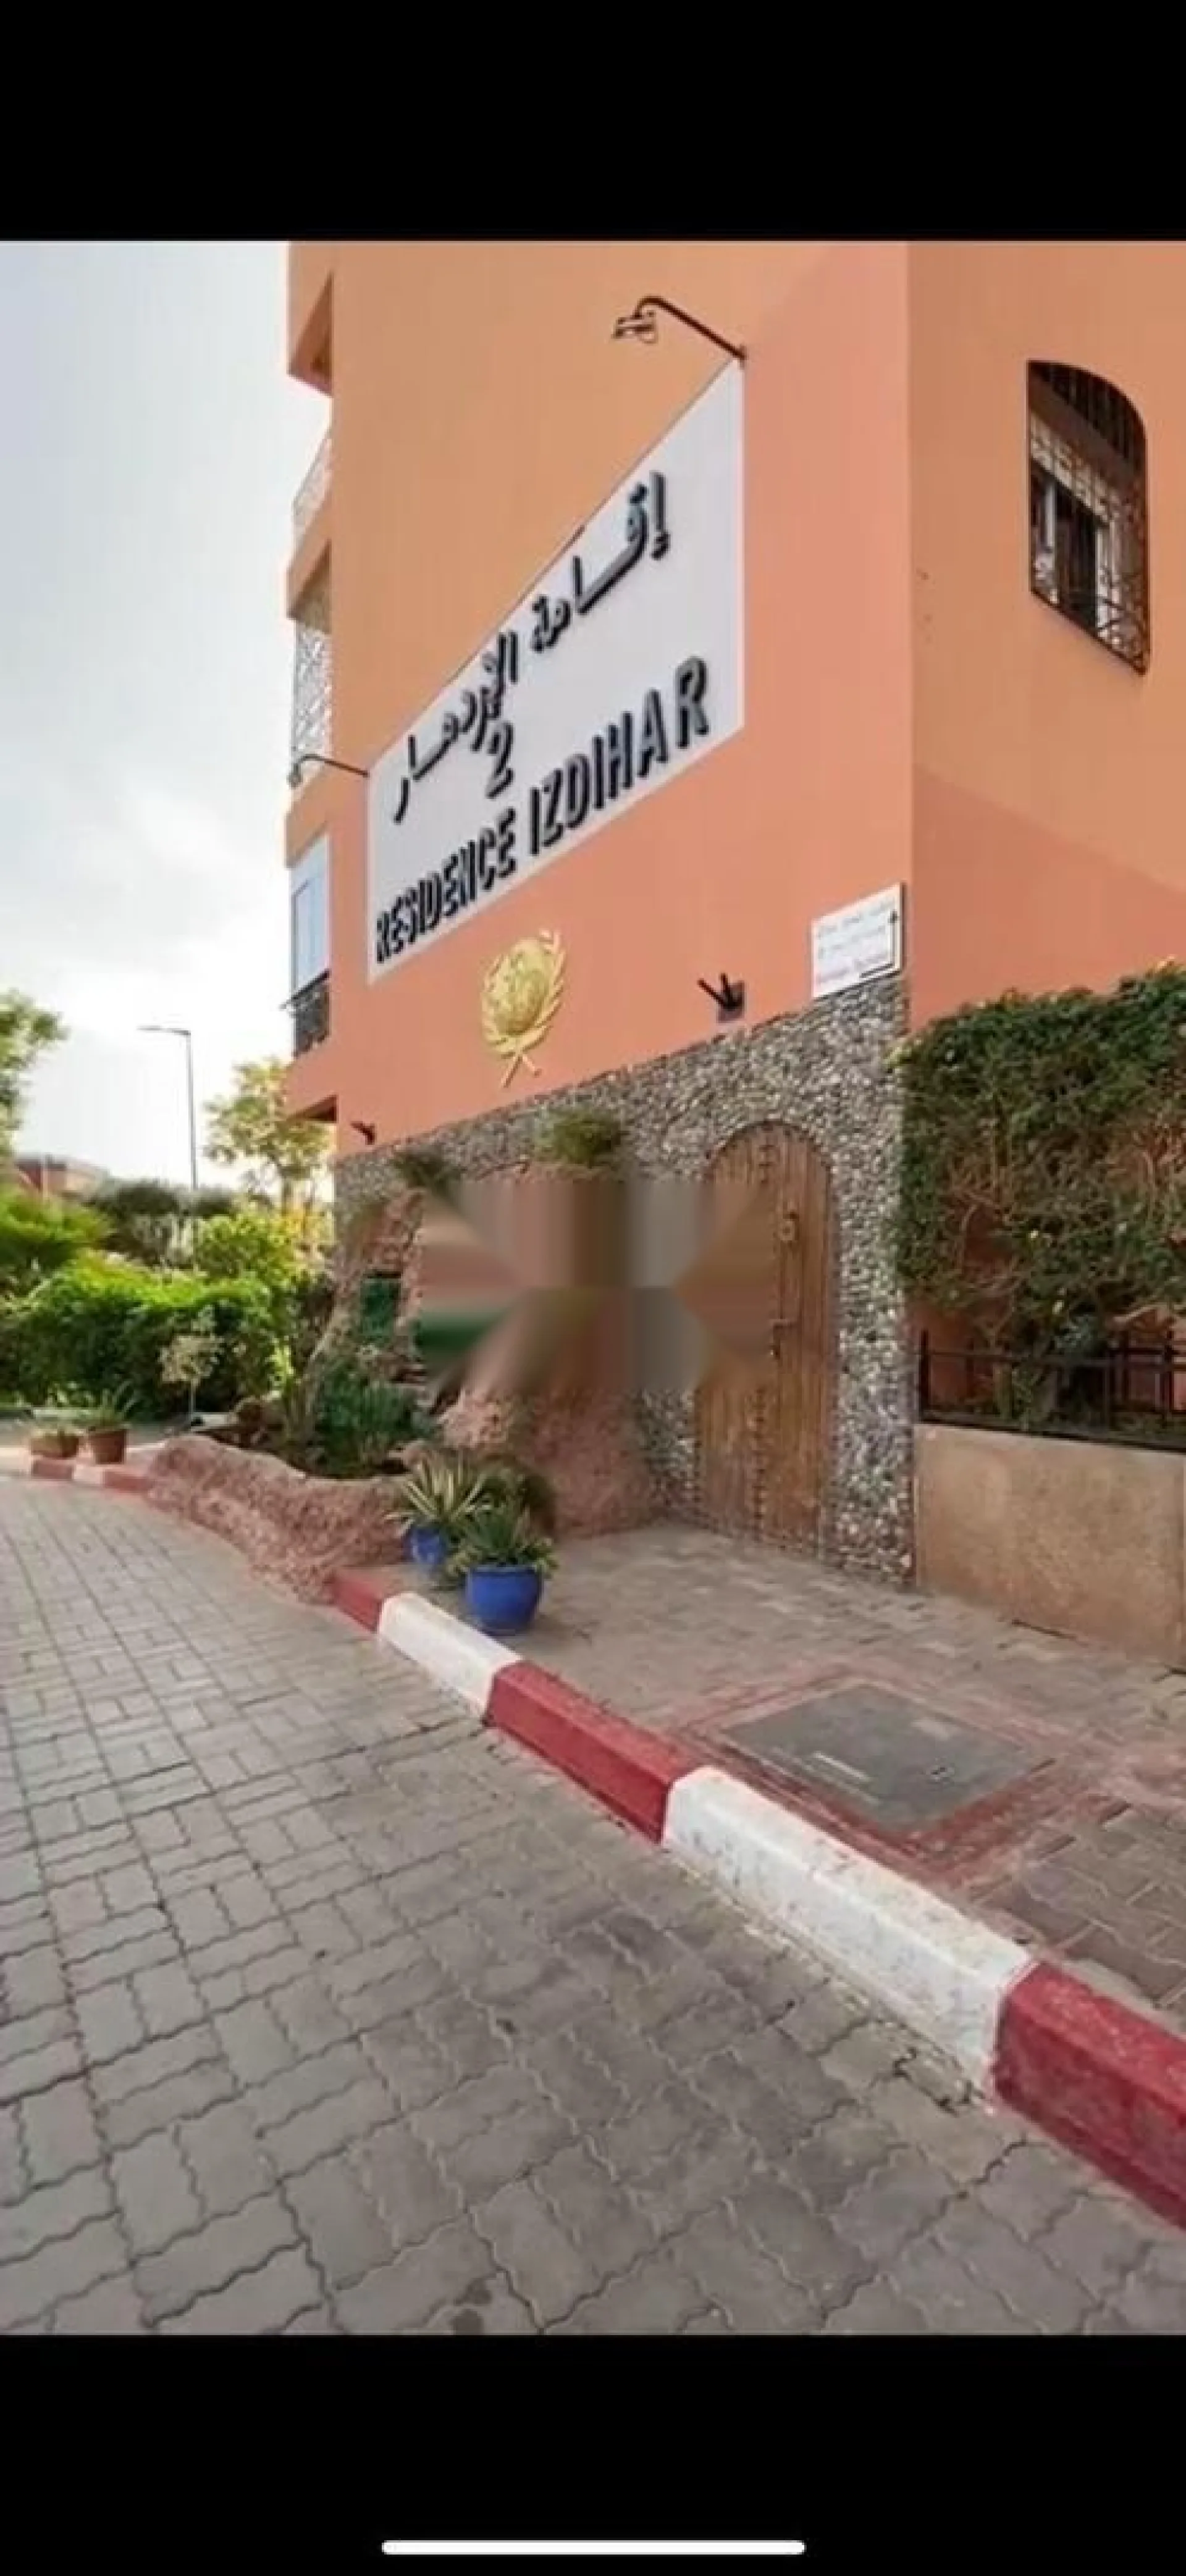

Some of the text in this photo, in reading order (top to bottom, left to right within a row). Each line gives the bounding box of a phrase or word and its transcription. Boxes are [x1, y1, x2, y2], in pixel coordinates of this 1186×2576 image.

[531, 470, 670, 653] إقامة
[376, 656, 709, 963] RESIDENCE IZDIHAR
[487, 721, 514, 799] 2
